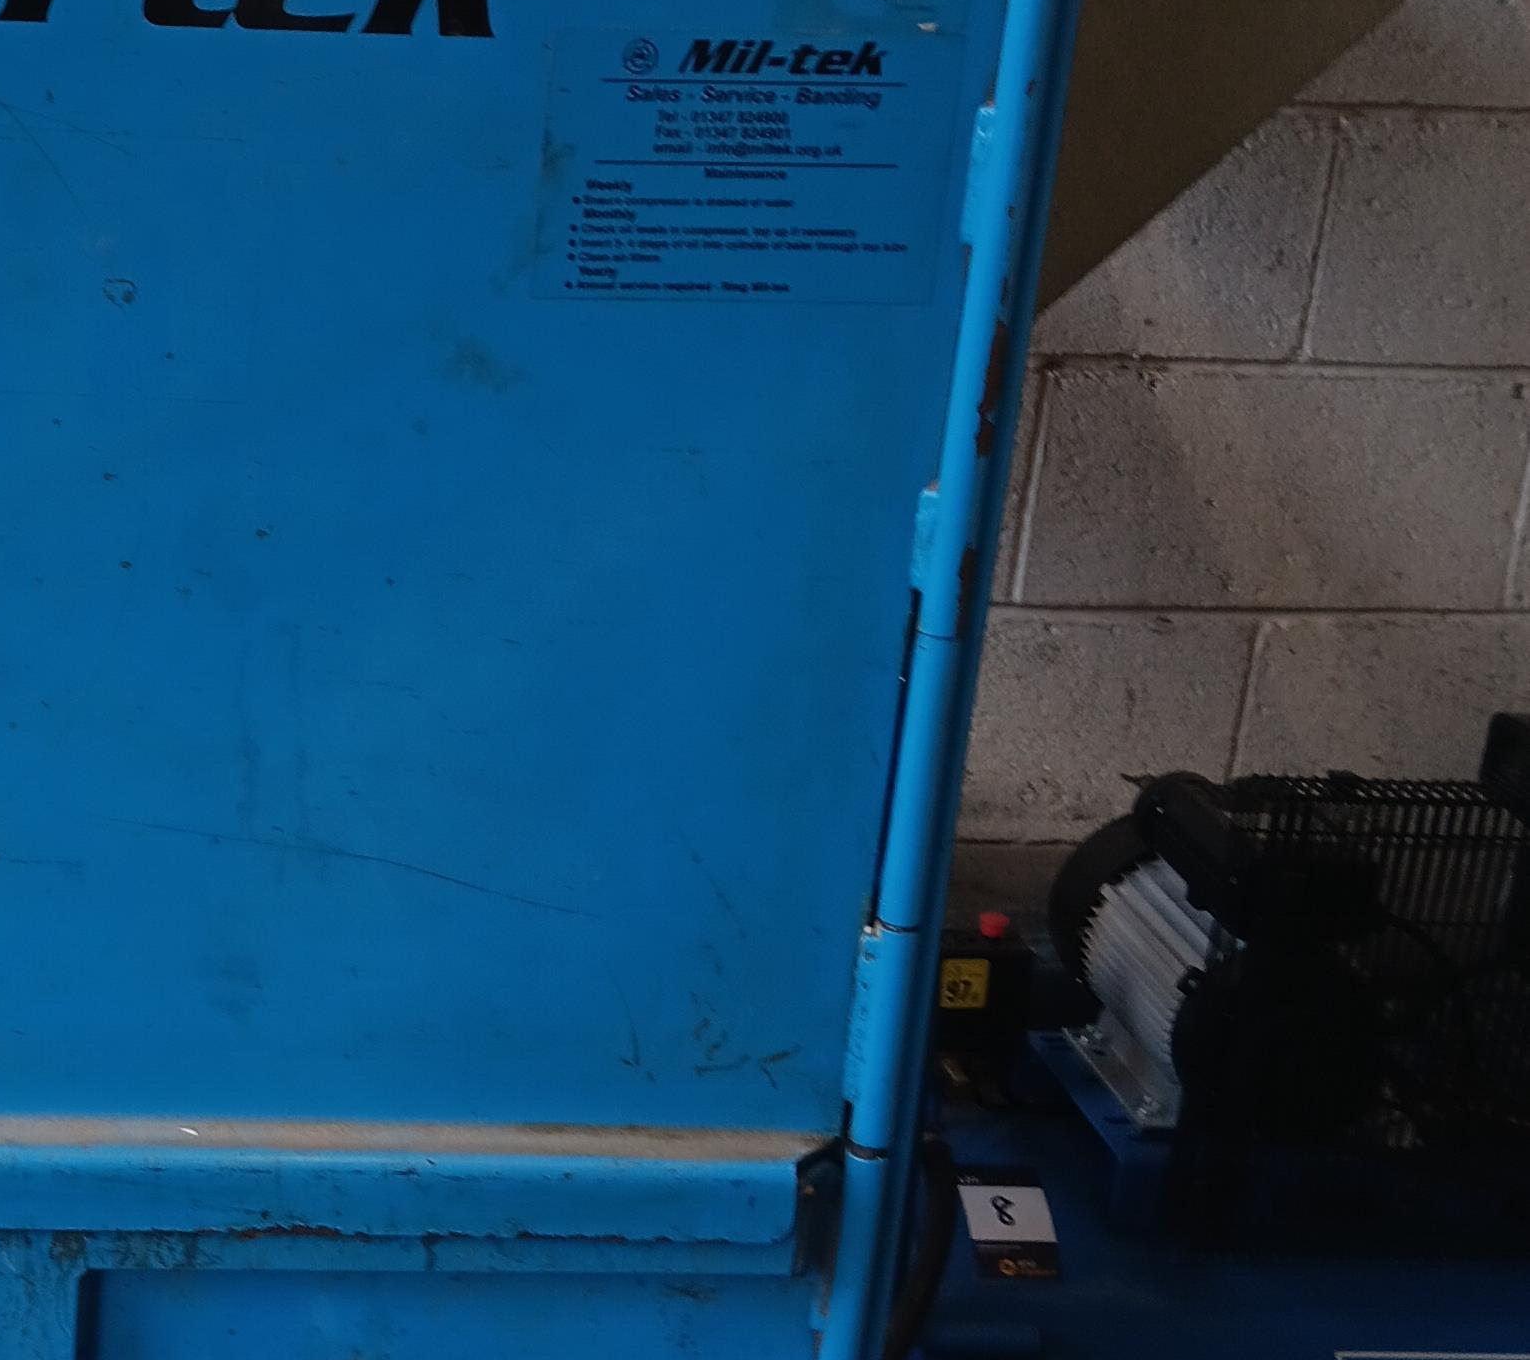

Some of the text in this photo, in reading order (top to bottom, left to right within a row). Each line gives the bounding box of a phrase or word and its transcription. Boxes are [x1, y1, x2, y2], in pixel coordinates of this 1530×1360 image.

[678, 38, 889, 77] Mil-tek
[626, 85, 882, 110] Sales Service Banding
